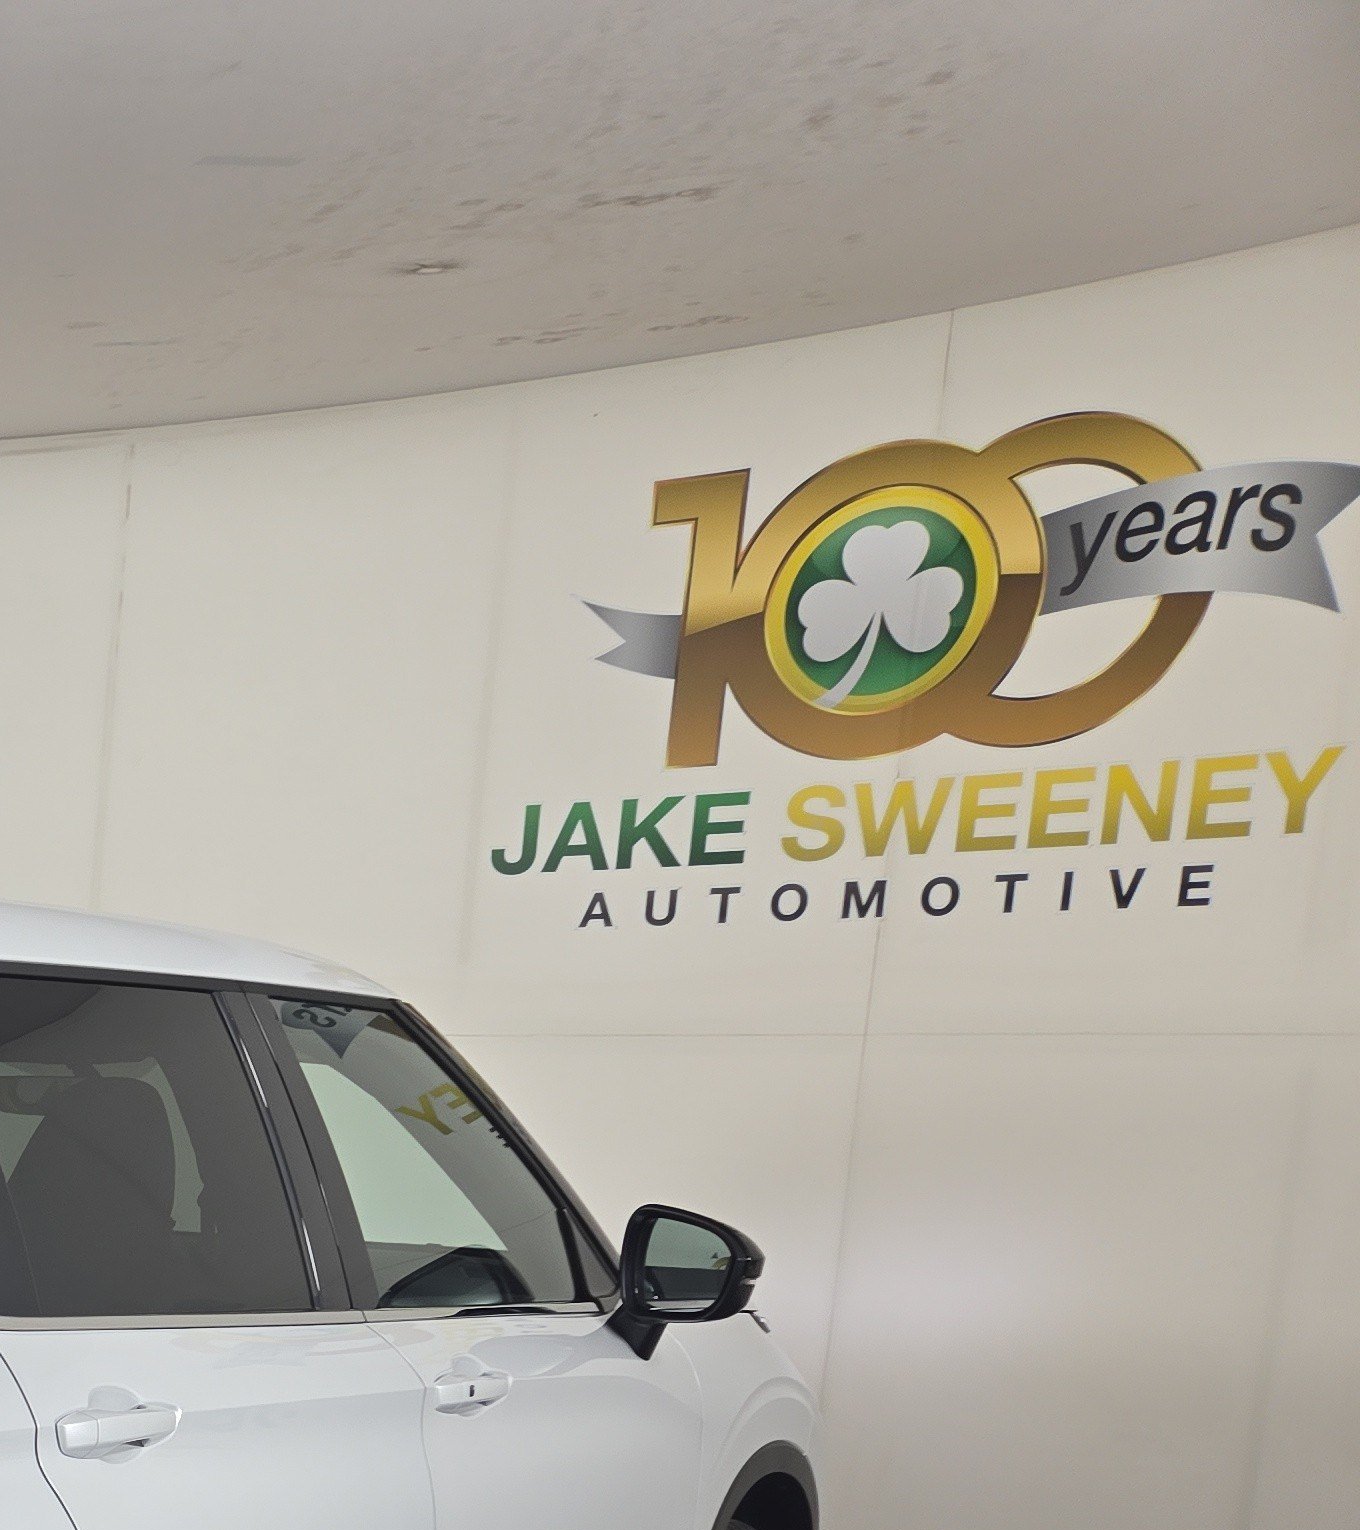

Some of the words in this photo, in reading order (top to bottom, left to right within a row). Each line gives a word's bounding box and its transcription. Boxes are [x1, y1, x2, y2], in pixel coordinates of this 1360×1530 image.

[1060, 480, 1302, 596] years
[489, 791, 750, 876] JAKE
[781, 746, 1346, 862] SWEENEY
[578, 864, 1215, 928] AUTOMOTIVE
